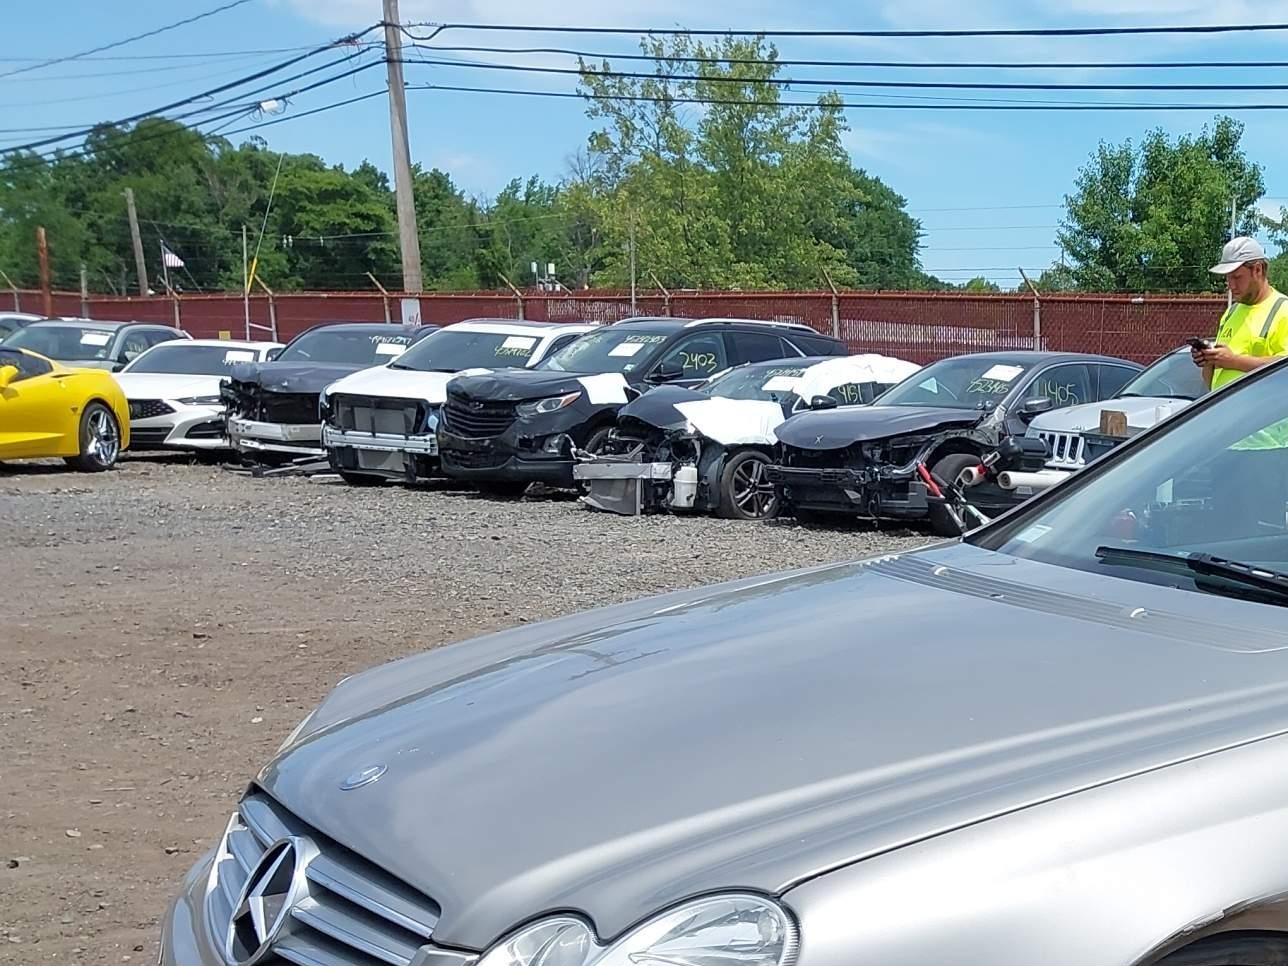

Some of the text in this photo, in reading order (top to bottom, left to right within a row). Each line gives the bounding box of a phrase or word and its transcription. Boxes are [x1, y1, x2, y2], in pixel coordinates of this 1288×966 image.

[679, 351, 718, 373] 2403
[837, 384, 863, 403] 9151
[1044, 380, 1079, 405] 1405
